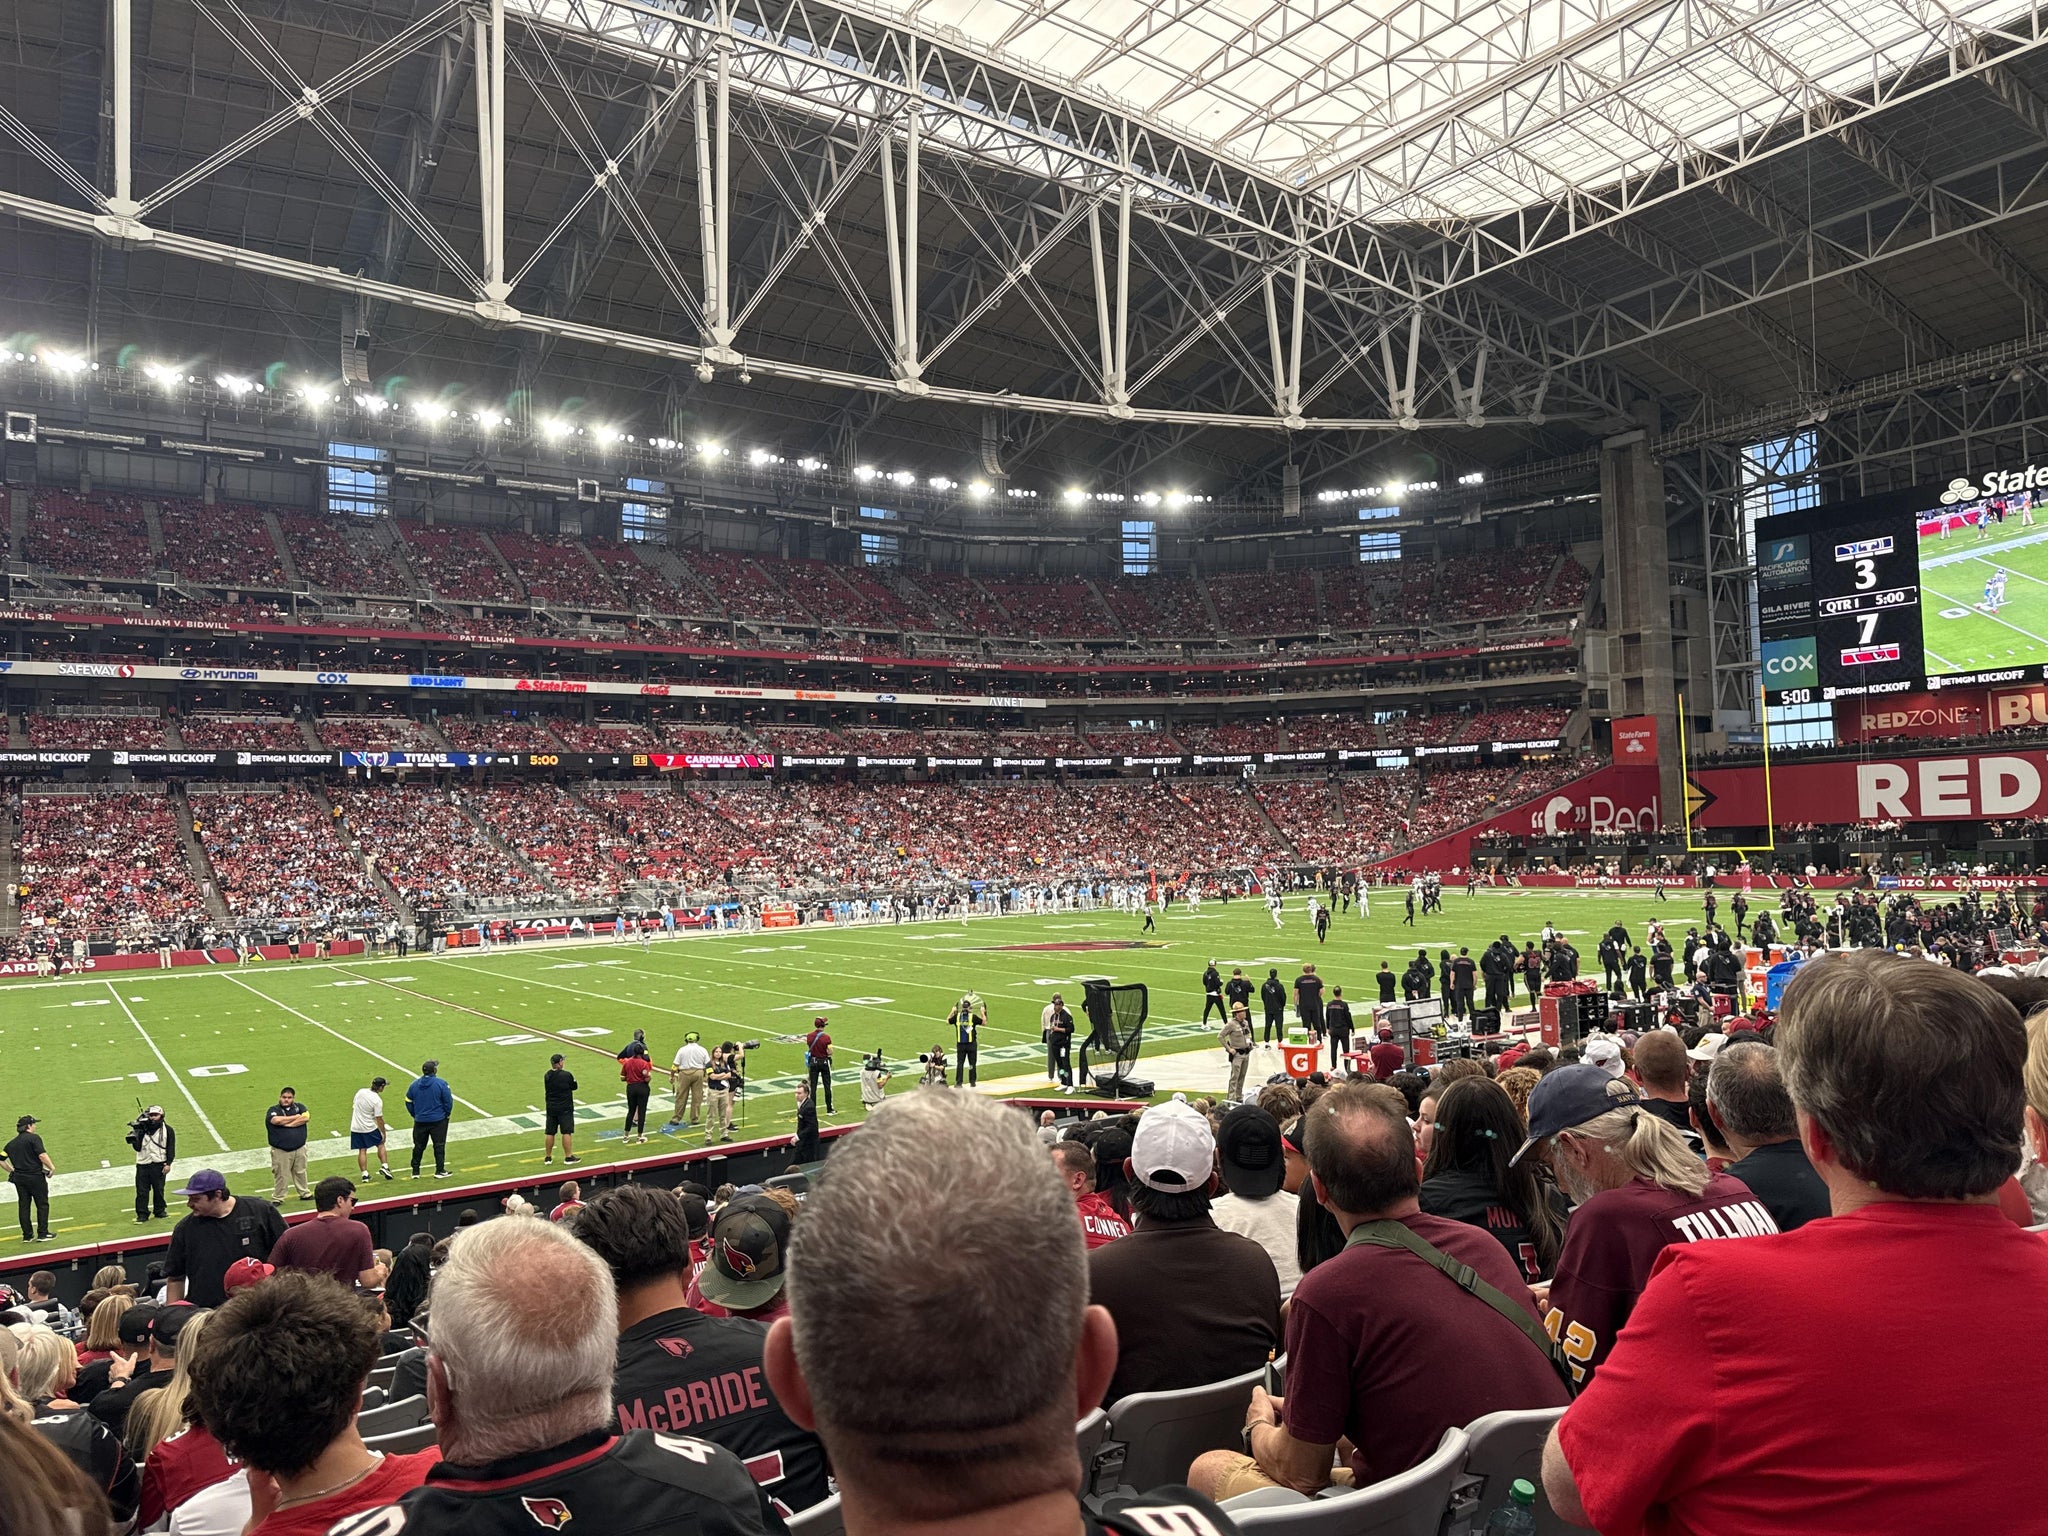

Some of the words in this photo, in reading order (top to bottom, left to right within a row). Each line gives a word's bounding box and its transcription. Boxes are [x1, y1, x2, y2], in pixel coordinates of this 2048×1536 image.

[1981, 464, 2048, 497] State
[1758, 562, 1785, 573] PACIFIC
[1786, 558, 1811, 568] OFFICE
[1762, 565, 1808, 578] AUTOMATION
[1854, 559, 1877, 590] 3
[1762, 605, 1783, 614] GILA
[1783, 601, 1811, 611] RIVER
[1826, 599, 1852, 614] QTR
[1875, 591, 1905, 606] 5:00
[38, 613, 56, 621] SR.
[123, 617, 171, 627] WILLIAM
[173, 619, 184, 627] V.
[186, 620, 231, 630] BIDWILL
[1856, 613, 1879, 645] 7
[459, 634, 476, 643] PAT
[478, 635, 515, 644] TILLMAN
[1501, 641, 1544, 651] CONZELMAN
[838, 655, 864, 663] WEHRLI
[1766, 654, 1814, 674] COX
[58, 664, 118, 677] SAFEWAY
[203, 670, 258, 681] HYUNDAI
[317, 673, 348, 684] COX
[410, 676, 433, 686] BUD
[434, 677, 464, 688] LIGHT
[1941, 675, 1976, 686] BETMGM
[1977, 670, 2025, 683] KICKOFF
[1836, 686, 1867, 696] BETMGM
[1869, 681, 1911, 693] KICKOFF
[989, 697, 1024, 707] AVNET
[1781, 689, 1811, 705] 5:00
[1861, 706, 1968, 731] REDZONE
[39, 752, 91, 763] KICKOFF
[129, 753, 167, 762] BETMGM
[169, 753, 217, 763] KICKOFF
[251, 754, 286, 763] BETMGM
[288, 754, 333, 764] KICKOFF
[403, 753, 447, 763] TITANS
[468, 754, 478, 766] 3
[511, 755, 519, 766] 1
[529, 755, 559, 766] 5:00
[634, 756, 647, 765] 25
[666, 755, 675, 766] 7
[685, 754, 741, 765] CARDINALS
[1857, 756, 2042, 818] RED
[1291, 1053, 1309, 1072] G
[617, 1366, 768, 1435] McBRIDE
